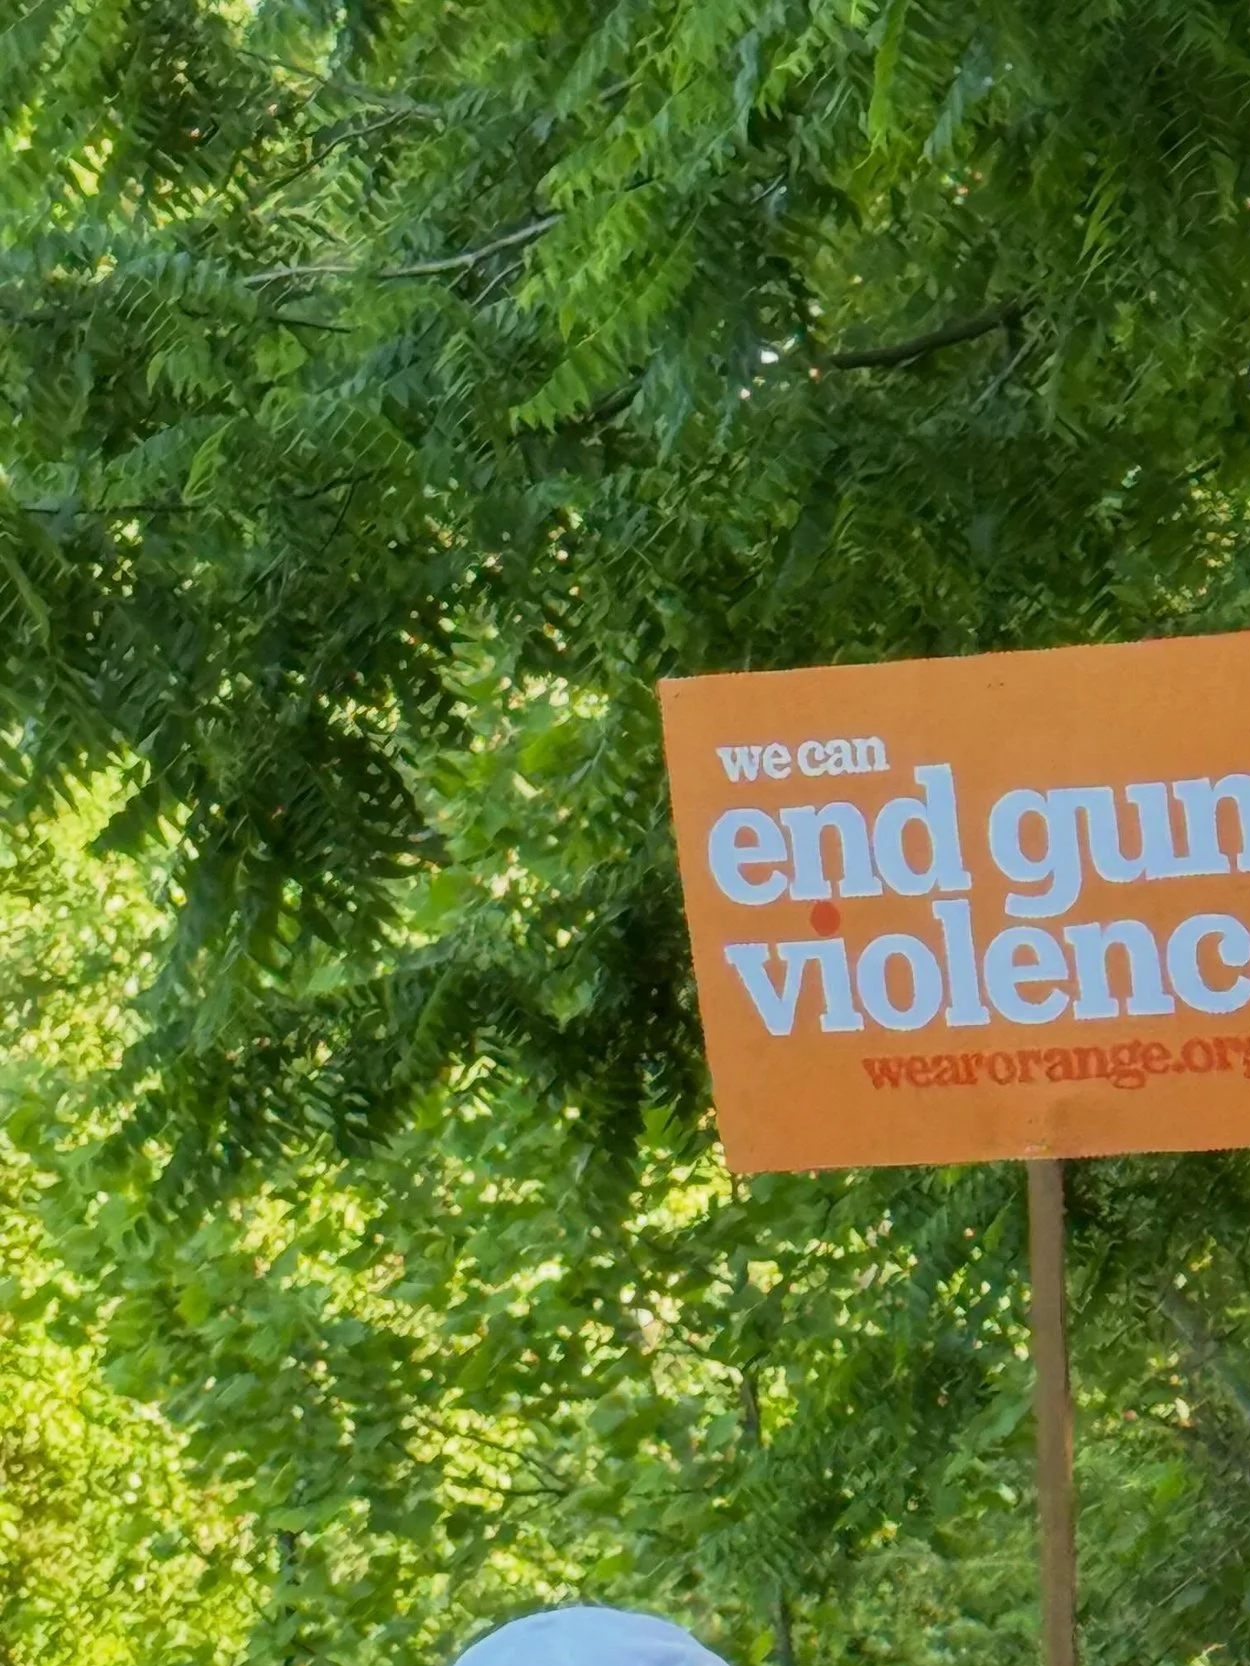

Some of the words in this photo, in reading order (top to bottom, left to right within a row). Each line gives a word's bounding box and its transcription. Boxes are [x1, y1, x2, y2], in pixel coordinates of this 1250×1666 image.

[716, 743, 791, 782] we
[798, 735, 890, 778] can
[708, 763, 972, 905] end
